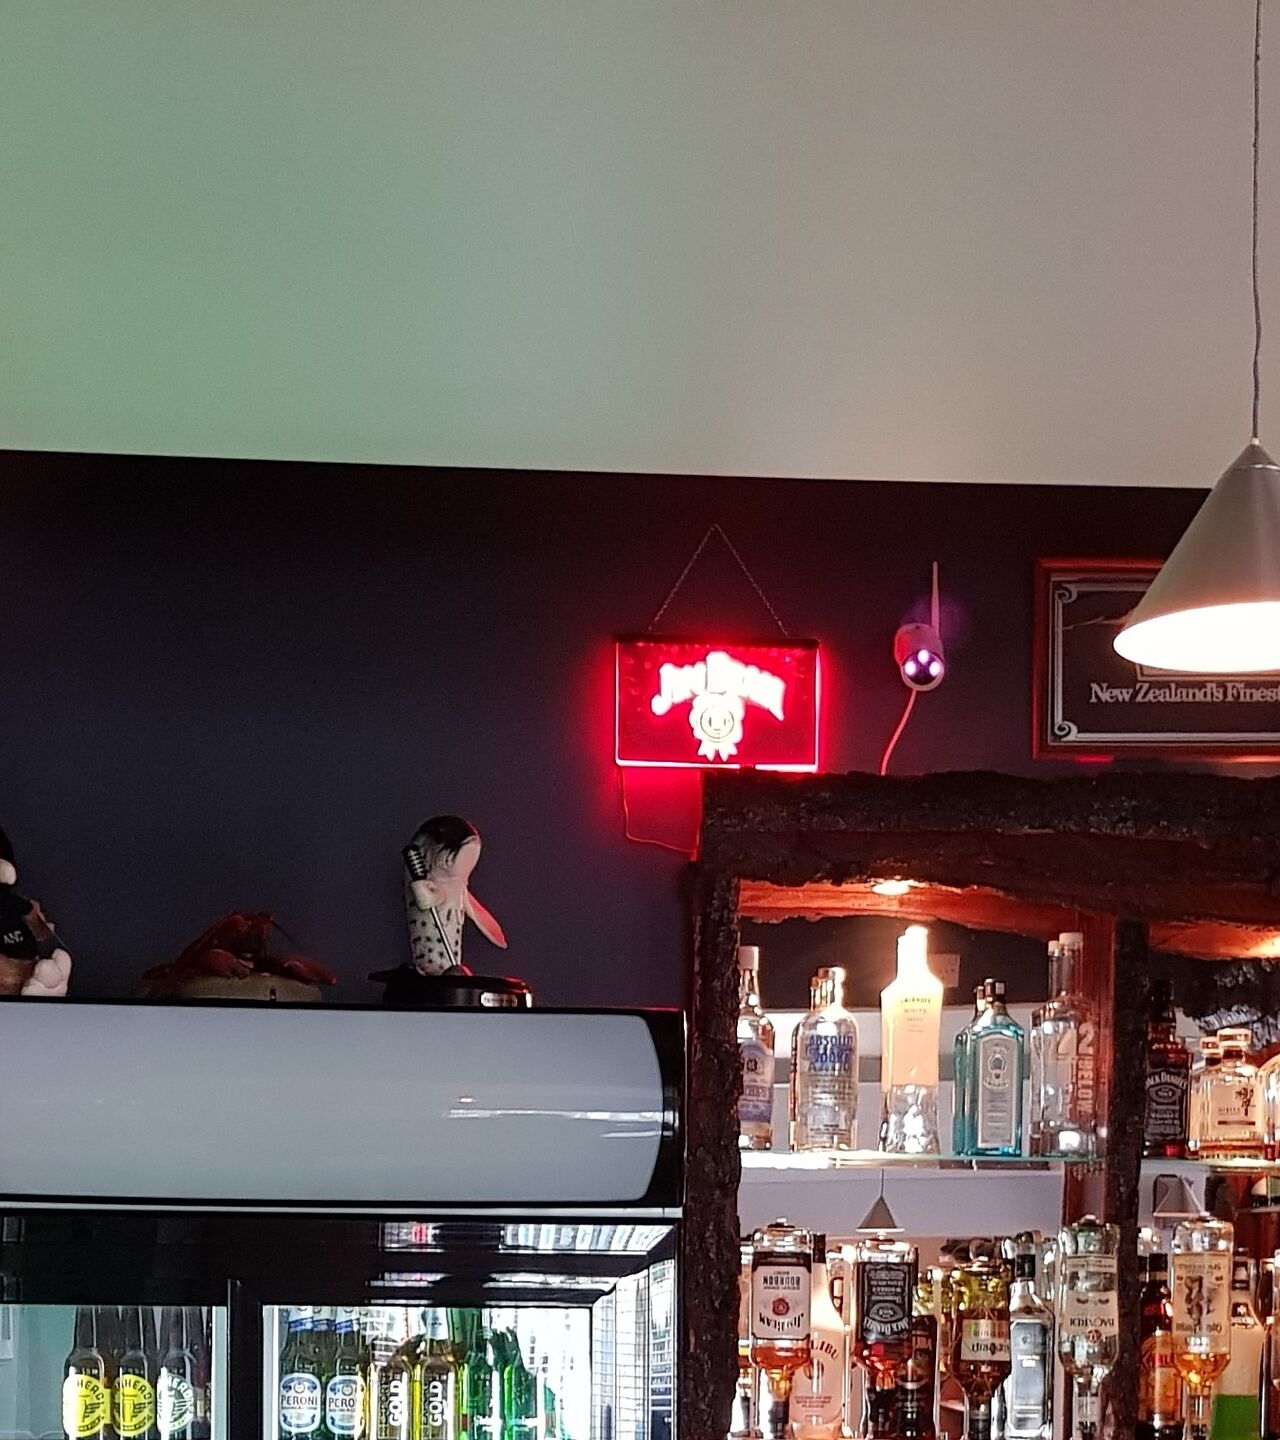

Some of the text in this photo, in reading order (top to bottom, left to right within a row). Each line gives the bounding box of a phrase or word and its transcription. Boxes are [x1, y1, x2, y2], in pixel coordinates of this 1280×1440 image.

[1089, 682, 1133, 703] New
[1136, 682, 1223, 703] Zealand's
[763, 1276, 800, 1286] BOURBON
[759, 1312, 804, 1332] JIM BEAM
[811, 1340, 839, 1359] LIBU
[281, 1395, 317, 1406] PERONI
[328, 1397, 355, 1409] PERO
[389, 1380, 402, 1427] GOLD
[429, 1380, 443, 1426] GOLD
